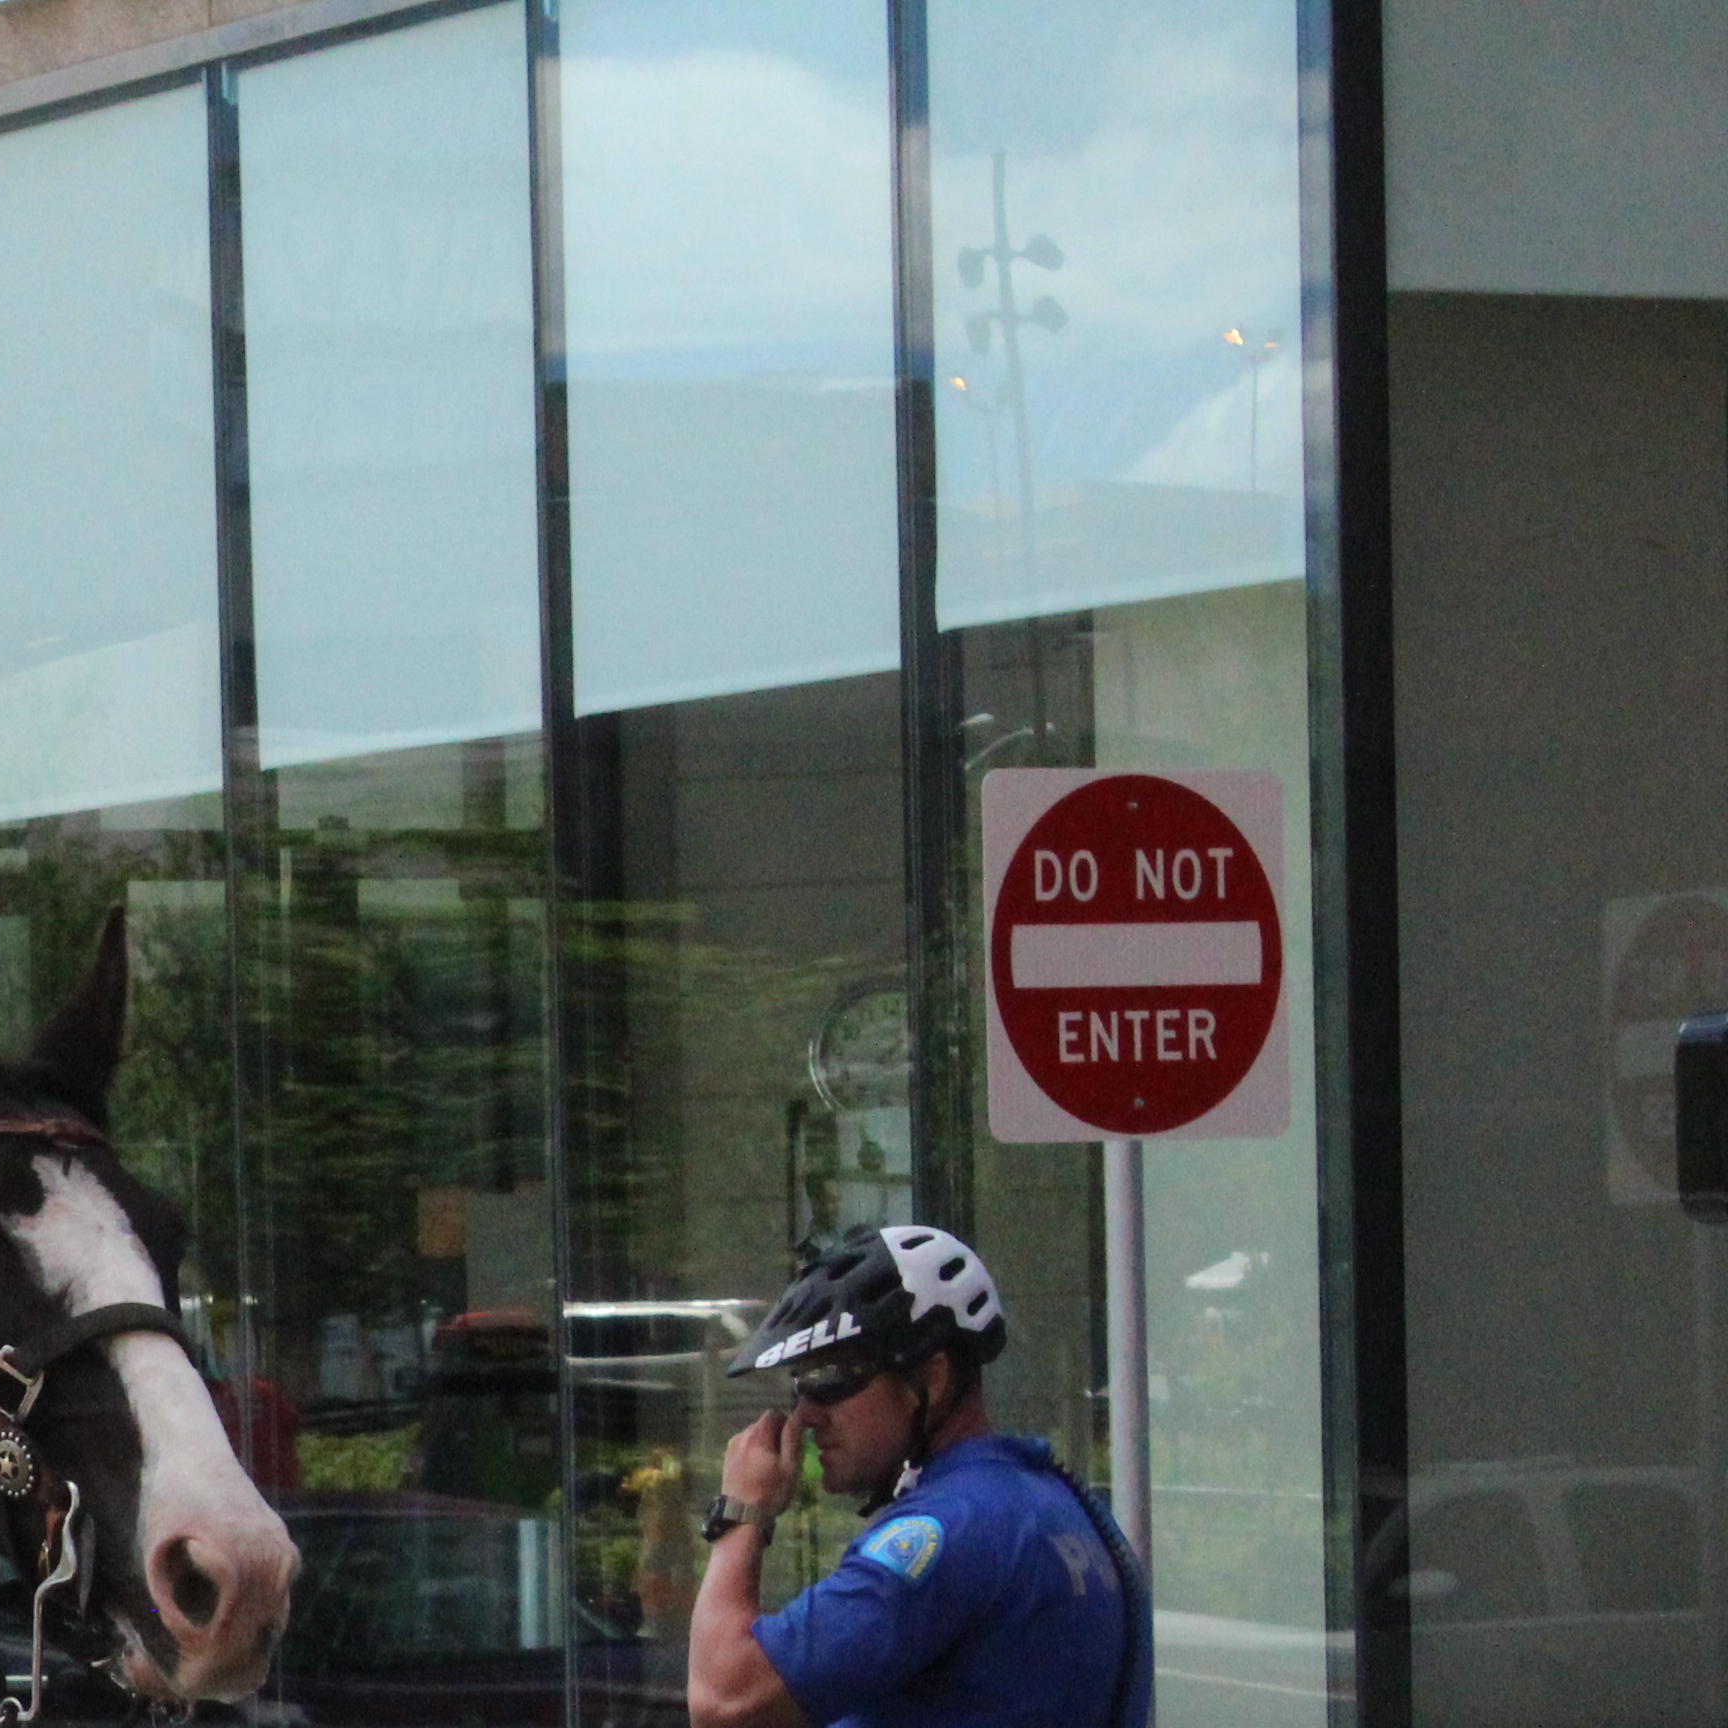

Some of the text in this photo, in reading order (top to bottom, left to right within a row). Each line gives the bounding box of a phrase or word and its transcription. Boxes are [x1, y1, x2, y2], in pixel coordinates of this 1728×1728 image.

[1034, 847, 1234, 902] DO NOT
[1058, 1009, 1217, 1064] ENTER
[755, 1311, 862, 1368] BELL
